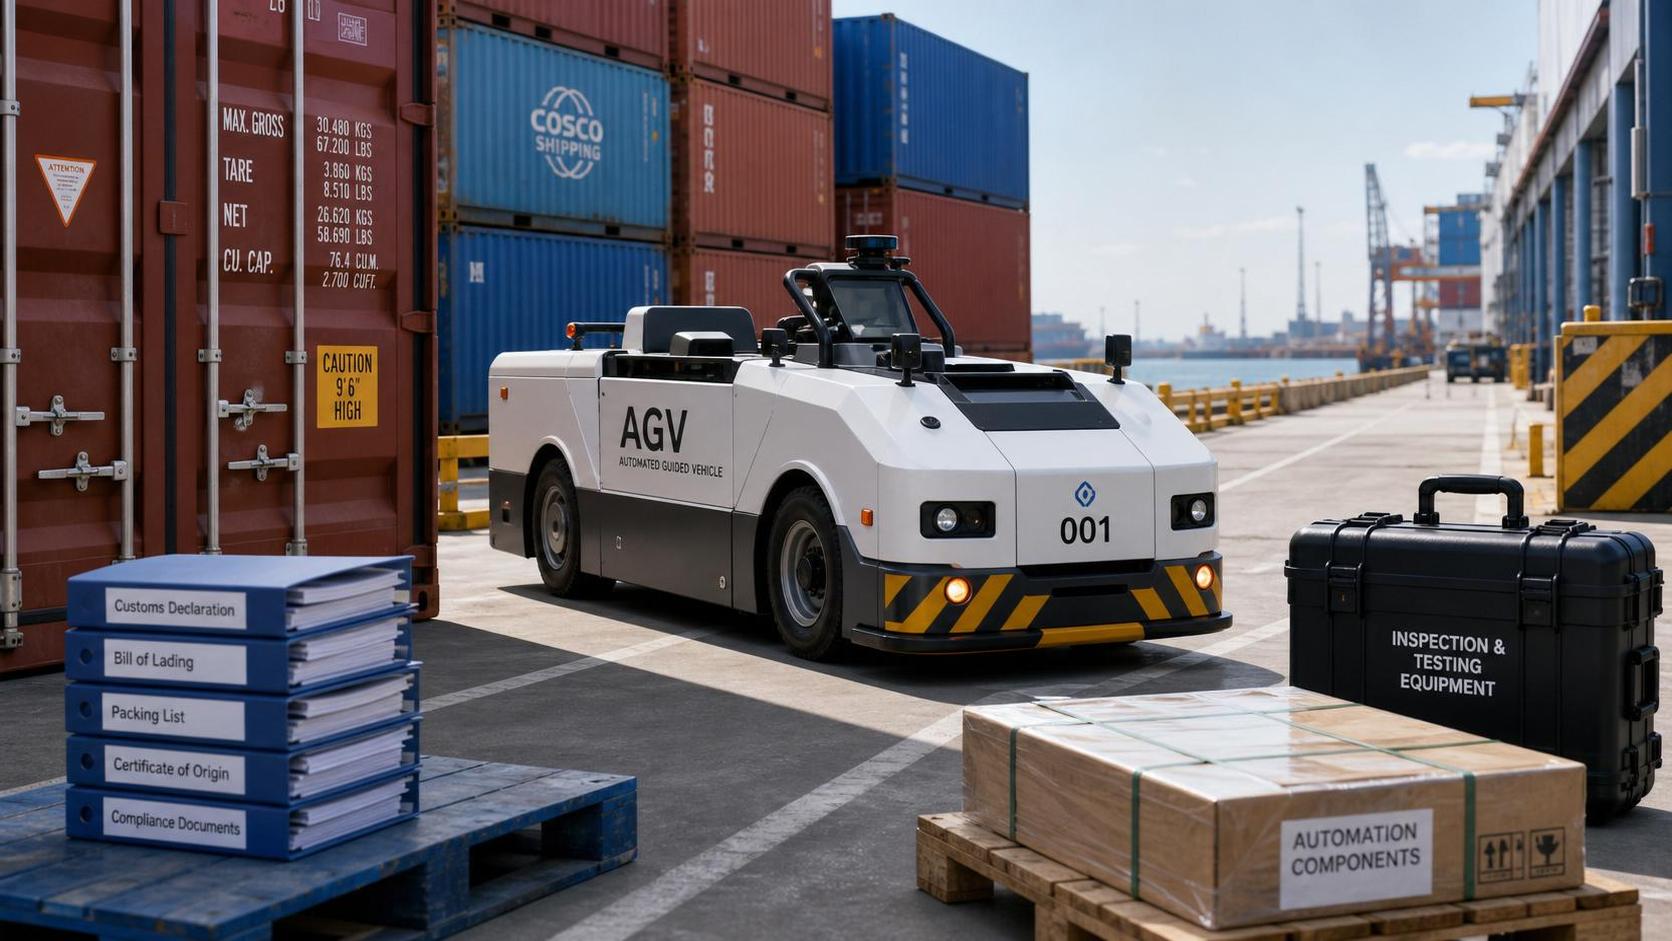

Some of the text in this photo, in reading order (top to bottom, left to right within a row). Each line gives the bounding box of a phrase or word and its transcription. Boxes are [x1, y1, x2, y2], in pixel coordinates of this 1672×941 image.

[223, 107, 284, 138] MAX. GROSS
[316, 116, 372, 139] 30.480 KGS
[530, 108, 604, 142] COSCO
[316, 136, 372, 158] 67.200 LBS
[536, 135, 600, 160] SHIPPING
[223, 157, 254, 183] TARE
[324, 161, 372, 182] 3.860 KGS
[324, 181, 372, 201] 8.510 LBS
[224, 203, 248, 228] NET
[318, 206, 373, 226] 26.620 KGS
[318, 226, 373, 245] 58.690 LBS
[224, 249, 273, 274] CU. CAP.
[330, 252, 379, 270] 76.4 CU.M.
[322, 271, 349, 288] 2.700
[323, 352, 372, 373] CAUTION
[335, 401, 361, 420] HIGH
[620, 406, 688, 453] AGV
[619, 456, 723, 478] AUTOMATED GUIDED VEHICLE
[1061, 516, 1110, 544] 001
[114, 599, 235, 617] Customs Declaration
[1392, 630, 1506, 655] INSPECTION &
[114, 651, 194, 672] Bill of Lading
[1414, 653, 1481, 674] TESTING
[1400, 673, 1496, 696] EQUIPMENT
[112, 705, 185, 724] Packing List
[114, 757, 229, 782] Certificate of Origin
[112, 810, 240, 836] Compliance Documents
[1292, 822, 1418, 850] AUTOMATION
[1292, 848, 1421, 876] COMPONENTS
